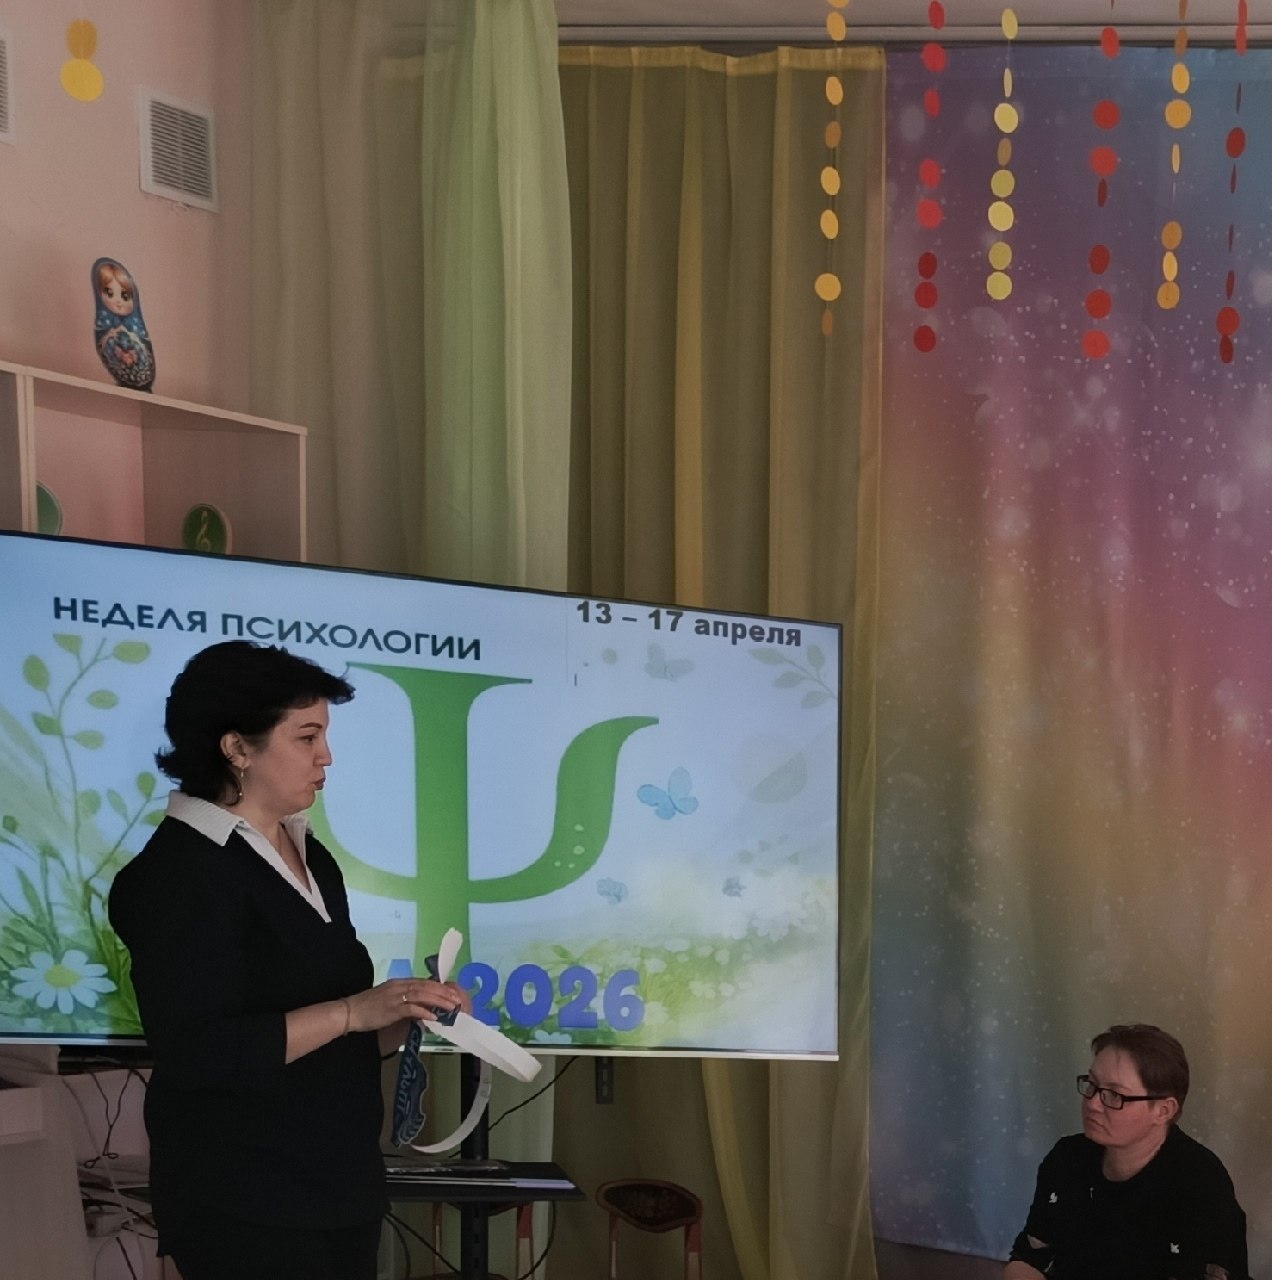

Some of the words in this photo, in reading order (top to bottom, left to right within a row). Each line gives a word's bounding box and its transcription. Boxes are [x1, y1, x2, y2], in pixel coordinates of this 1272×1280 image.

[53, 596, 207, 633] НЕДЕЛЯ
[221, 613, 481, 660] ПСИХОЛОГИИ
[577, 600, 612, 625] 13
[648, 609, 684, 632] 17
[694, 618, 802, 647] апреля
[457, 961, 646, 1032] 2026
